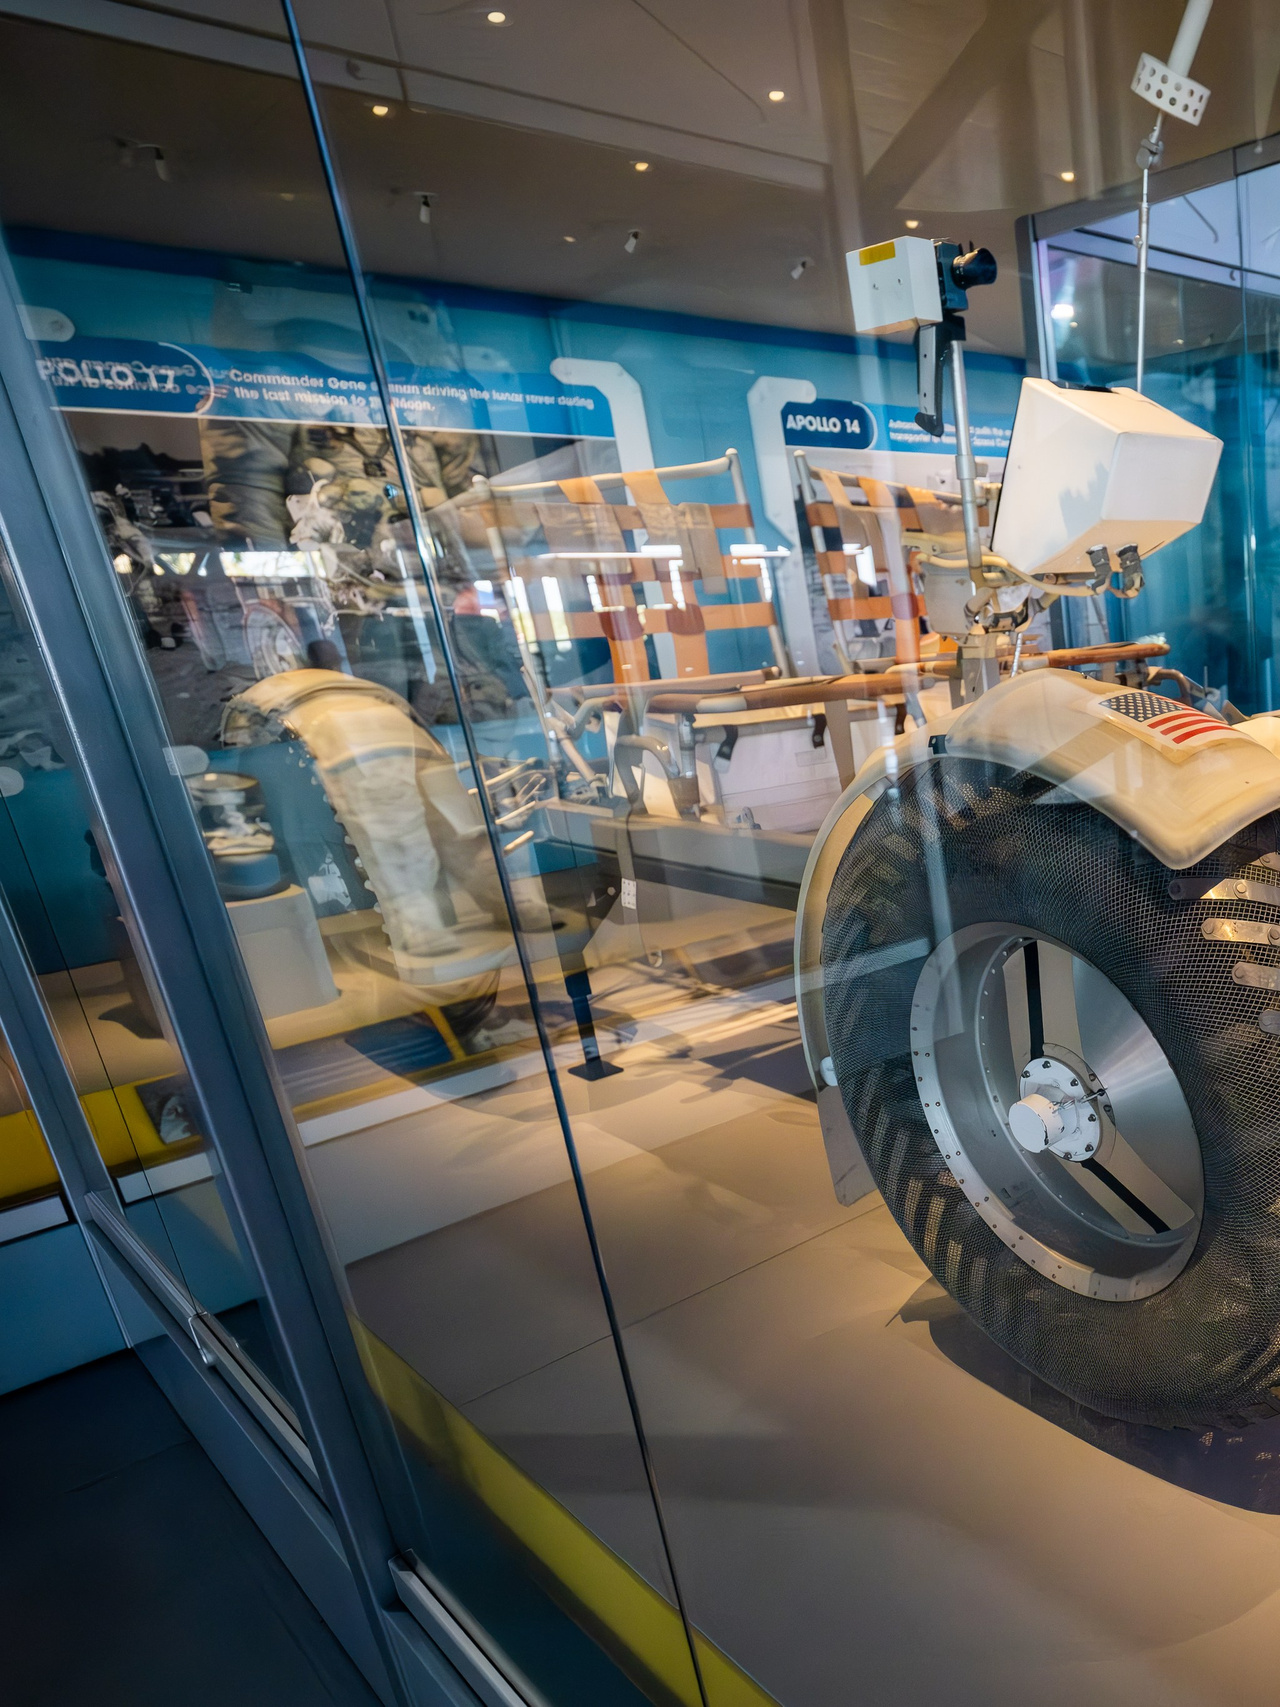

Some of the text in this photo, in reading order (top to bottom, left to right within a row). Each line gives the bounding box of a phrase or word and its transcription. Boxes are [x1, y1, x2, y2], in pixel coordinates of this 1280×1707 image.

[229, 368, 324, 388] Commander
[328, 377, 367, 391] Gene
[423, 384, 468, 402] driving
[470, 387, 491, 399] the
[492, 390, 524, 403] lunar
[525, 394, 555, 405] rover
[557, 395, 595, 410] during
[234, 386, 260, 400] the
[262, 388, 291, 402] last
[294, 391, 349, 407] mission
[351, 394, 367, 408] to
[786, 414, 861, 434] APOLLO 14
